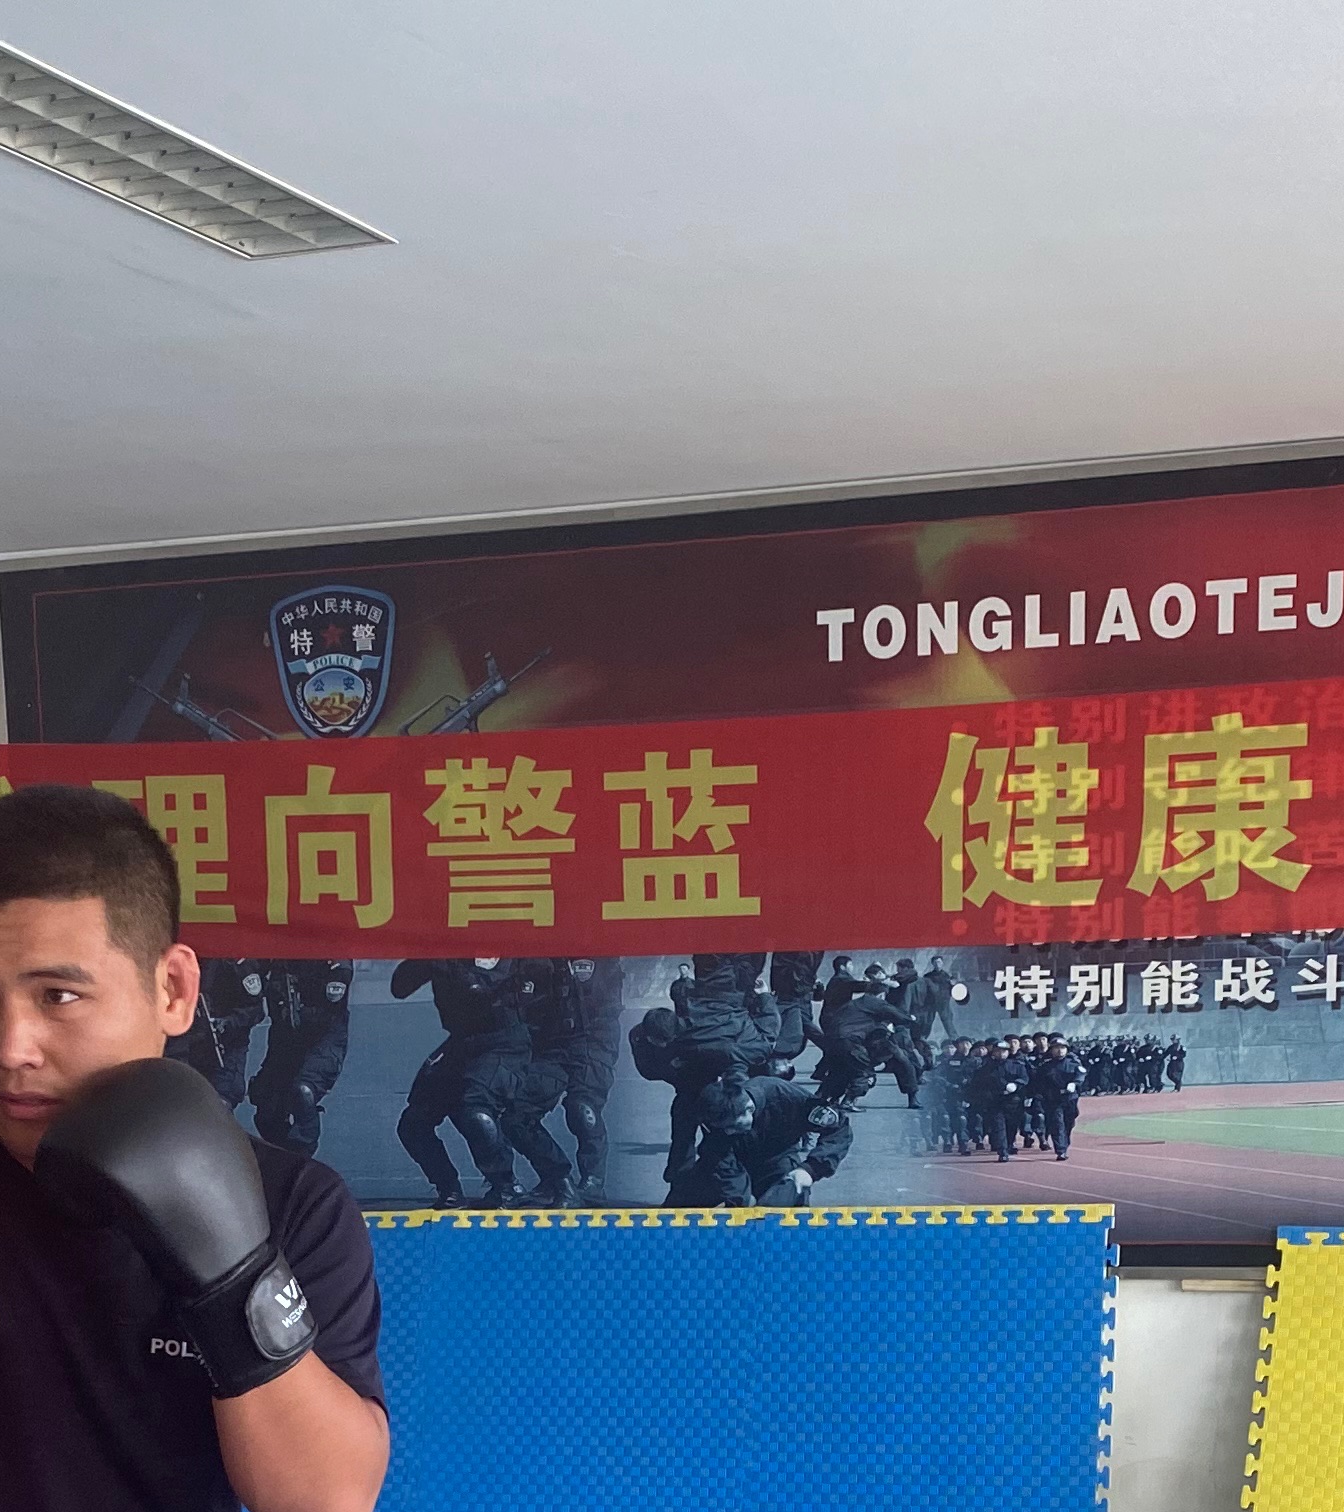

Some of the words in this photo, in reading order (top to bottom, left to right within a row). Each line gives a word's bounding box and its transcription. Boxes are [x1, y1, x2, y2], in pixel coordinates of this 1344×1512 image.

[281, 598, 383, 627] 中华人民共和国
[312, 656, 355, 669] POLICE
[150, 1338, 202, 1361] POL
